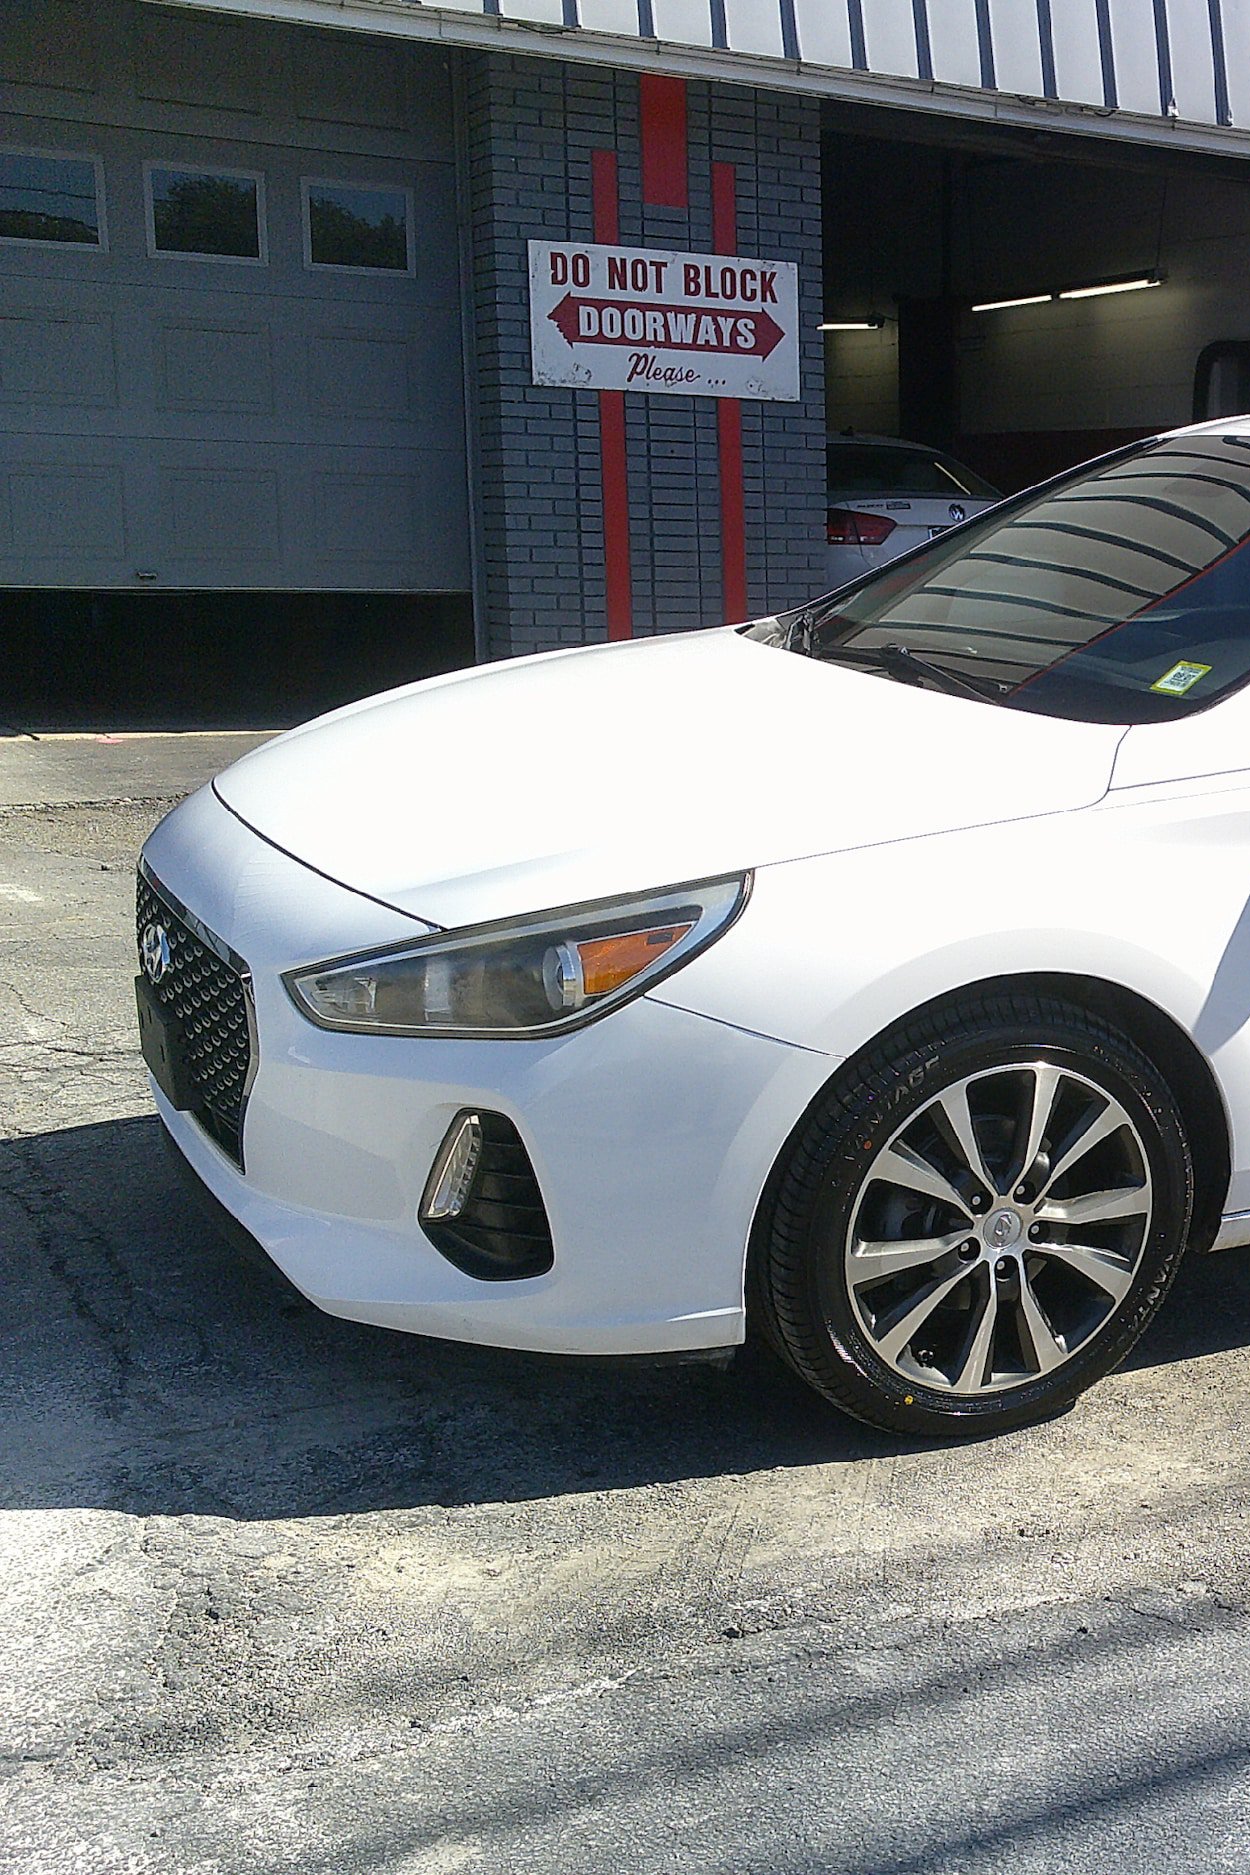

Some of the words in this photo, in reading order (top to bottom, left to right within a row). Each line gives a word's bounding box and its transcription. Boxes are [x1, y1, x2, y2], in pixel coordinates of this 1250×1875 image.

[550, 252, 591, 288] DO
[608, 257, 668, 293] NOT
[684, 263, 778, 303] BLOCK
[578, 305, 757, 349] DOORWAYS
[627, 353, 701, 382] Please
